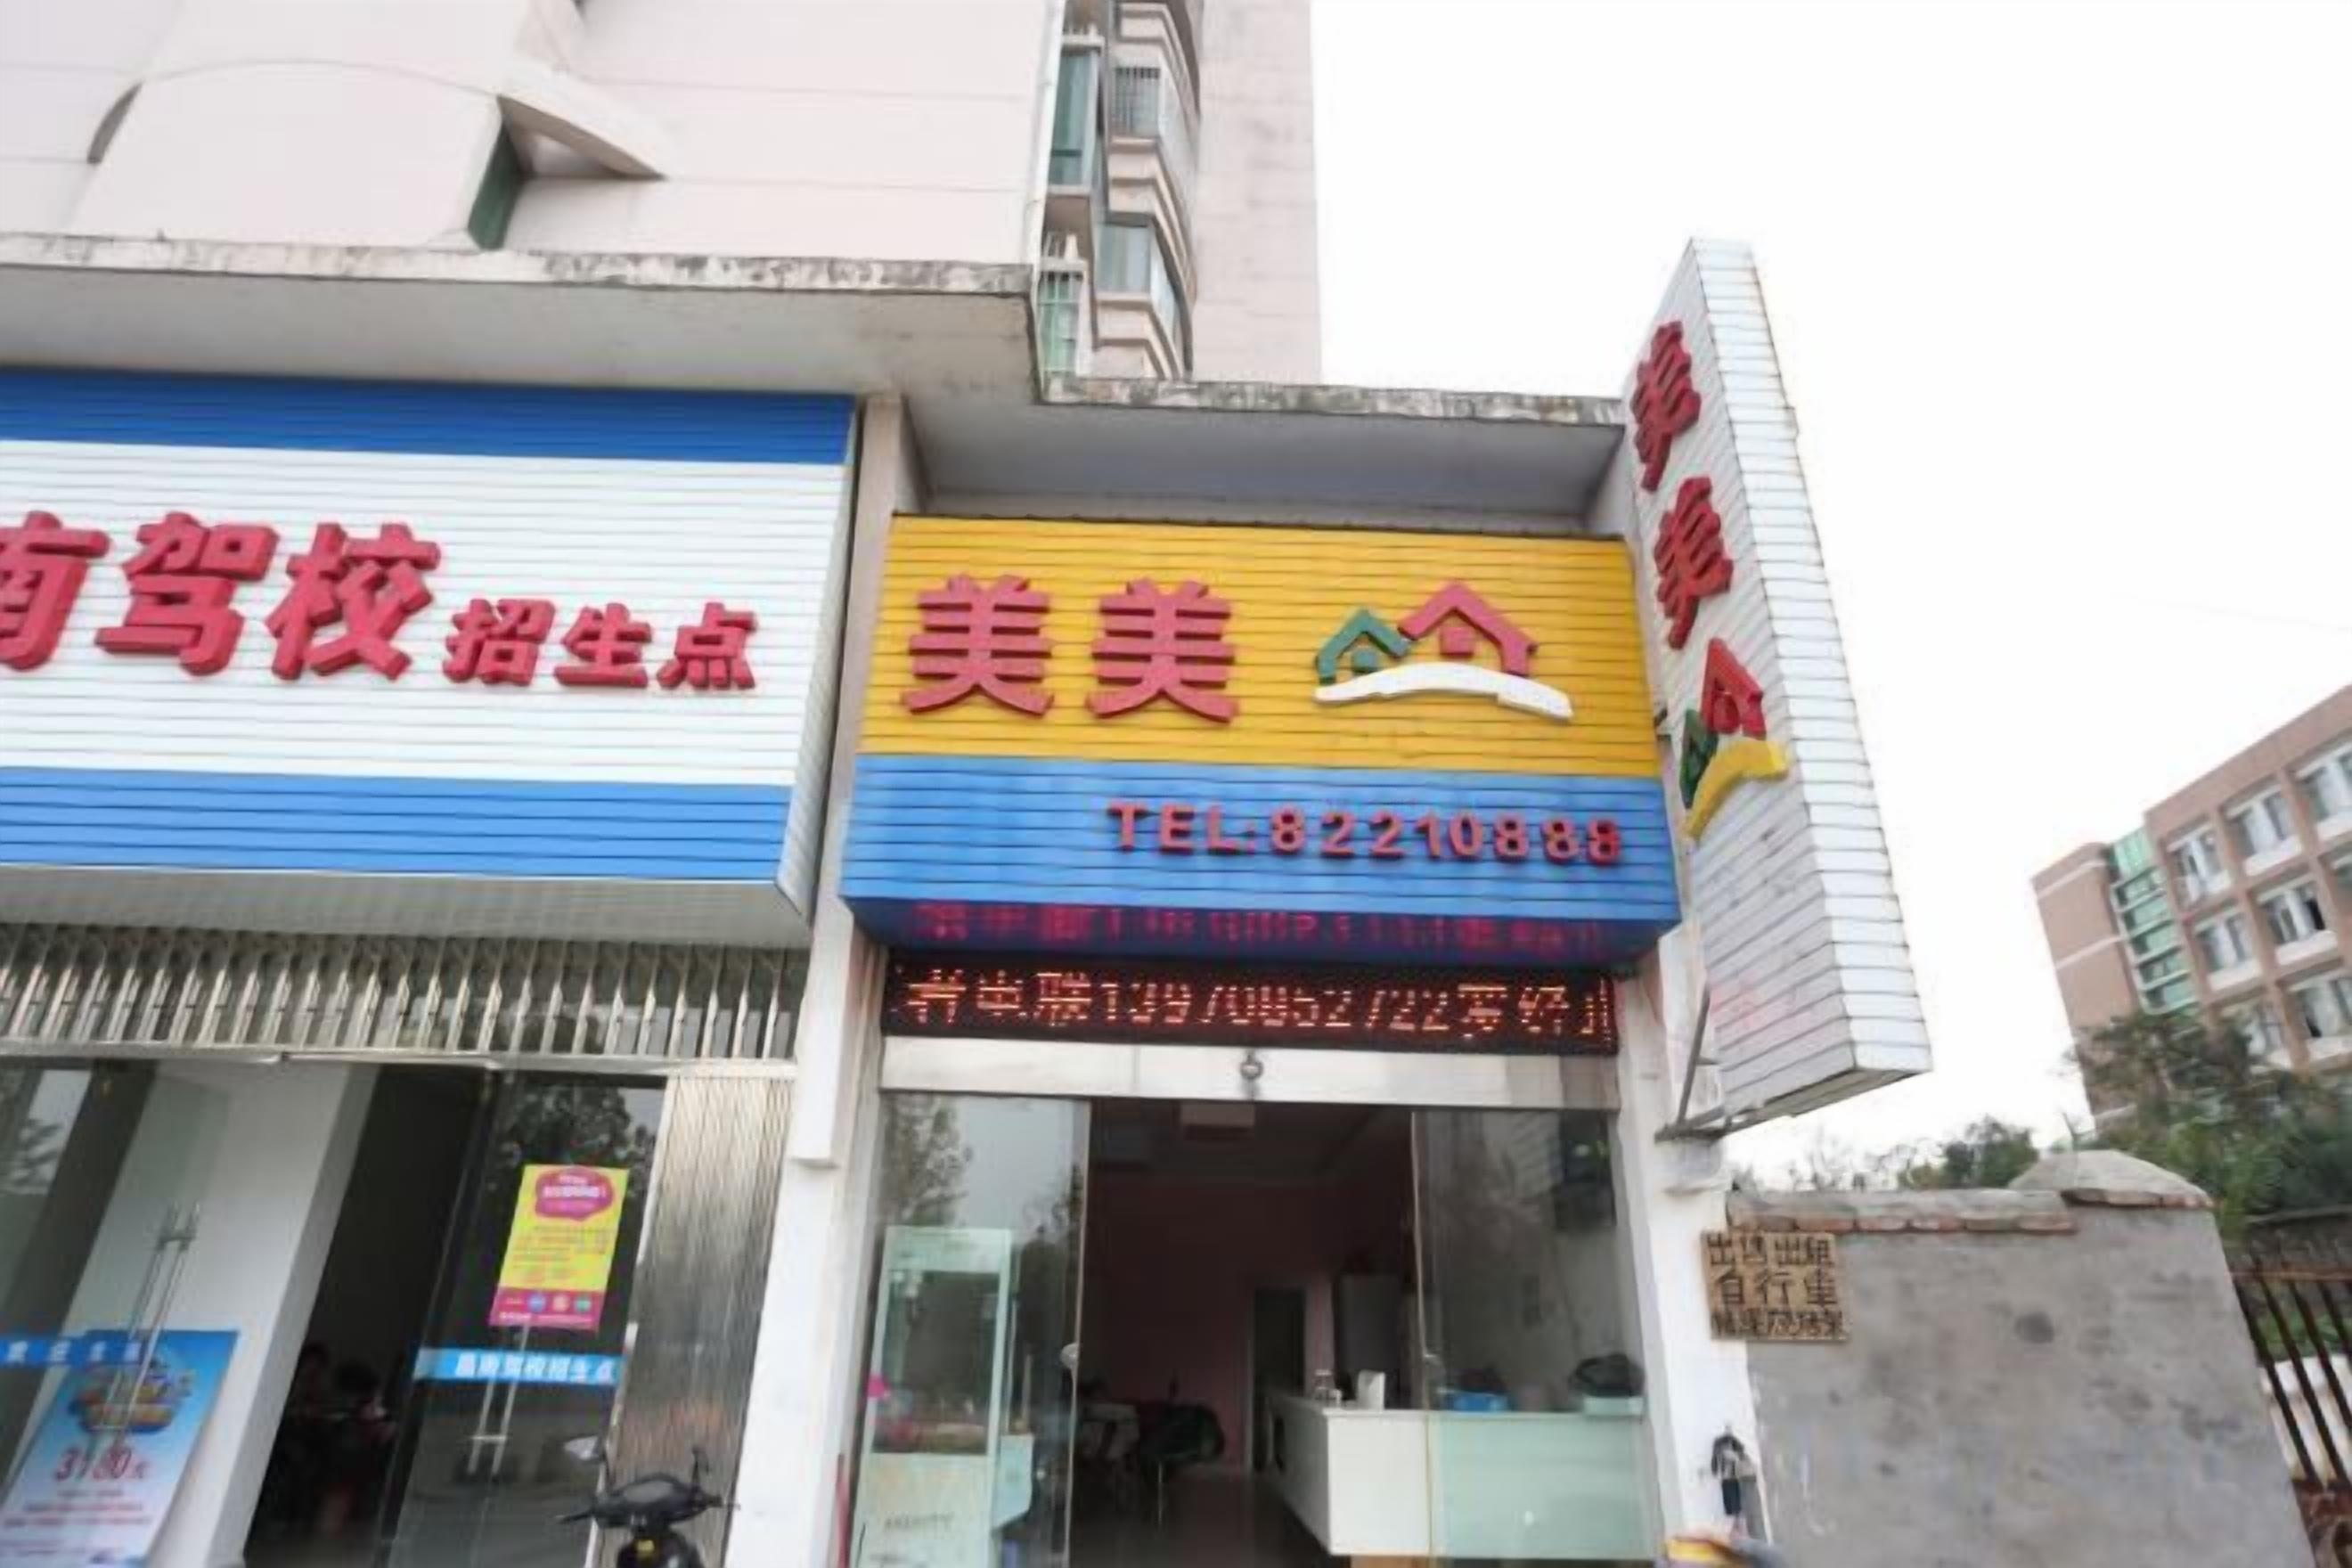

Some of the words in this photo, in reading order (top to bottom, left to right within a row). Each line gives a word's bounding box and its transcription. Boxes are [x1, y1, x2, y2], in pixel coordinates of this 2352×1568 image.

[1629, 321, 1734, 650] 美美
[443, 598, 759, 691] 招生点
[902, 575, 1239, 724] 美美
